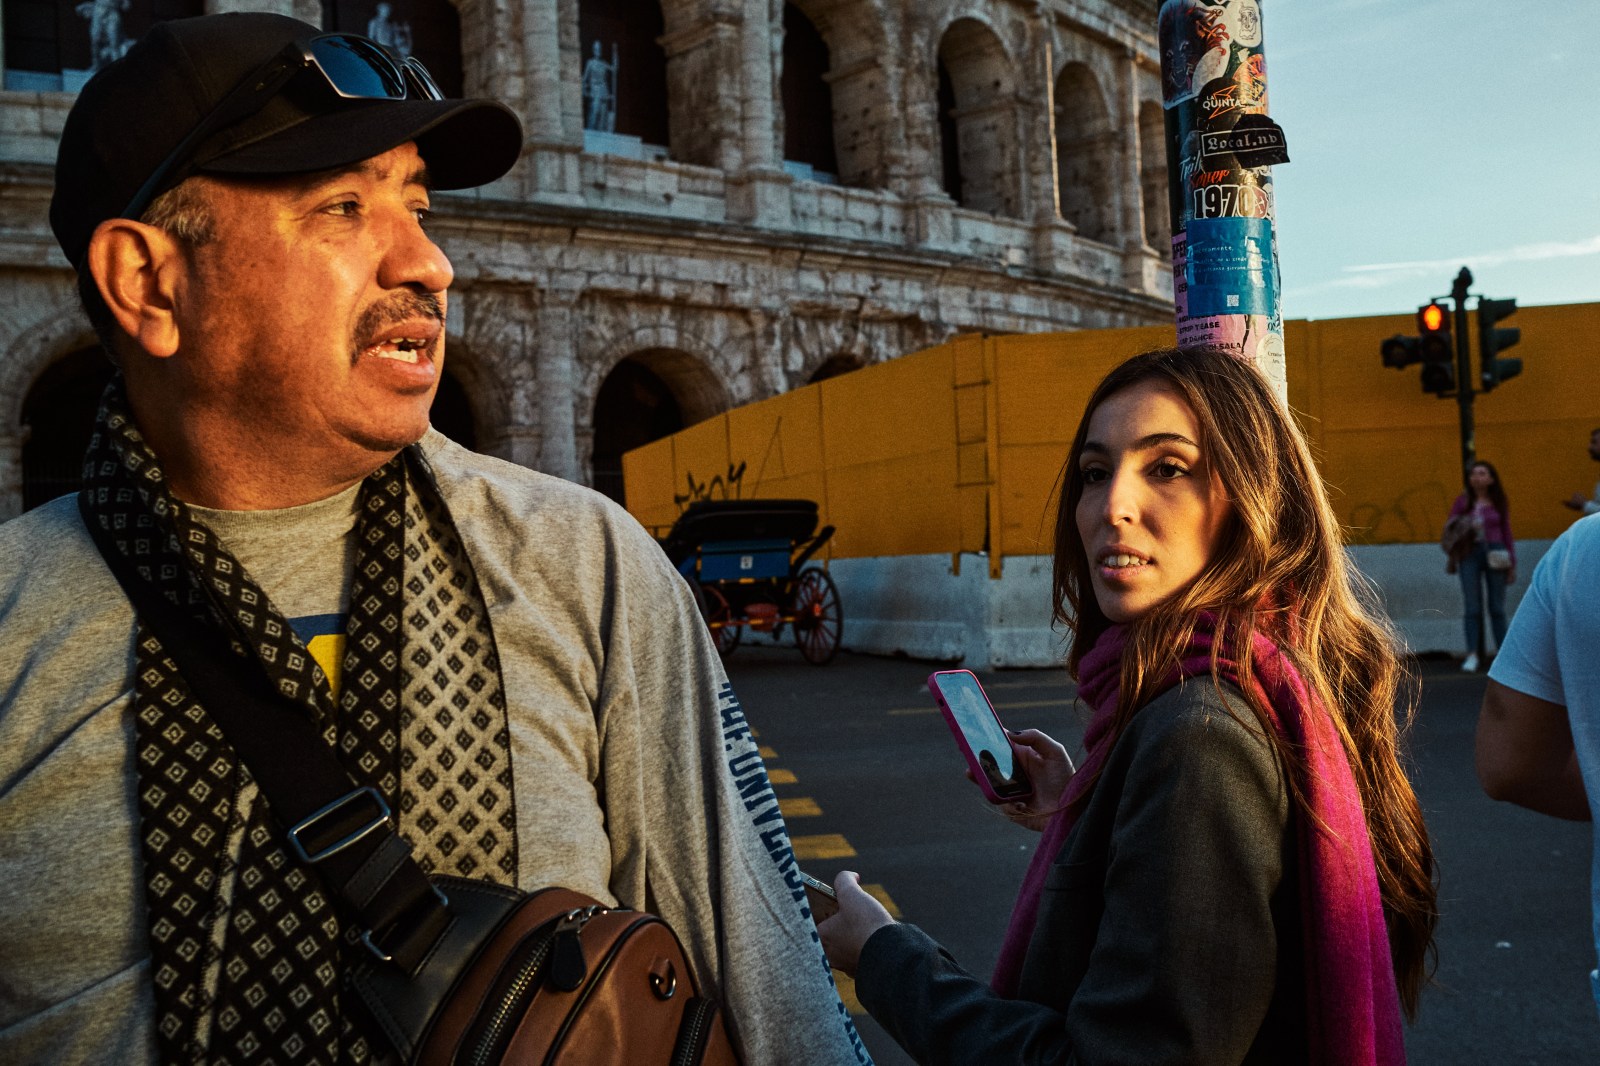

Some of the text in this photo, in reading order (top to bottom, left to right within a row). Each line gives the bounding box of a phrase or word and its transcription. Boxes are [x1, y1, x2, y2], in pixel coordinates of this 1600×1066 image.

[1202, 98, 1242, 111] QUINTA
[1194, 184, 1256, 220] 1970
[1195, 321, 1220, 331] TEASE
[1189, 333, 1214, 343] DANCE
